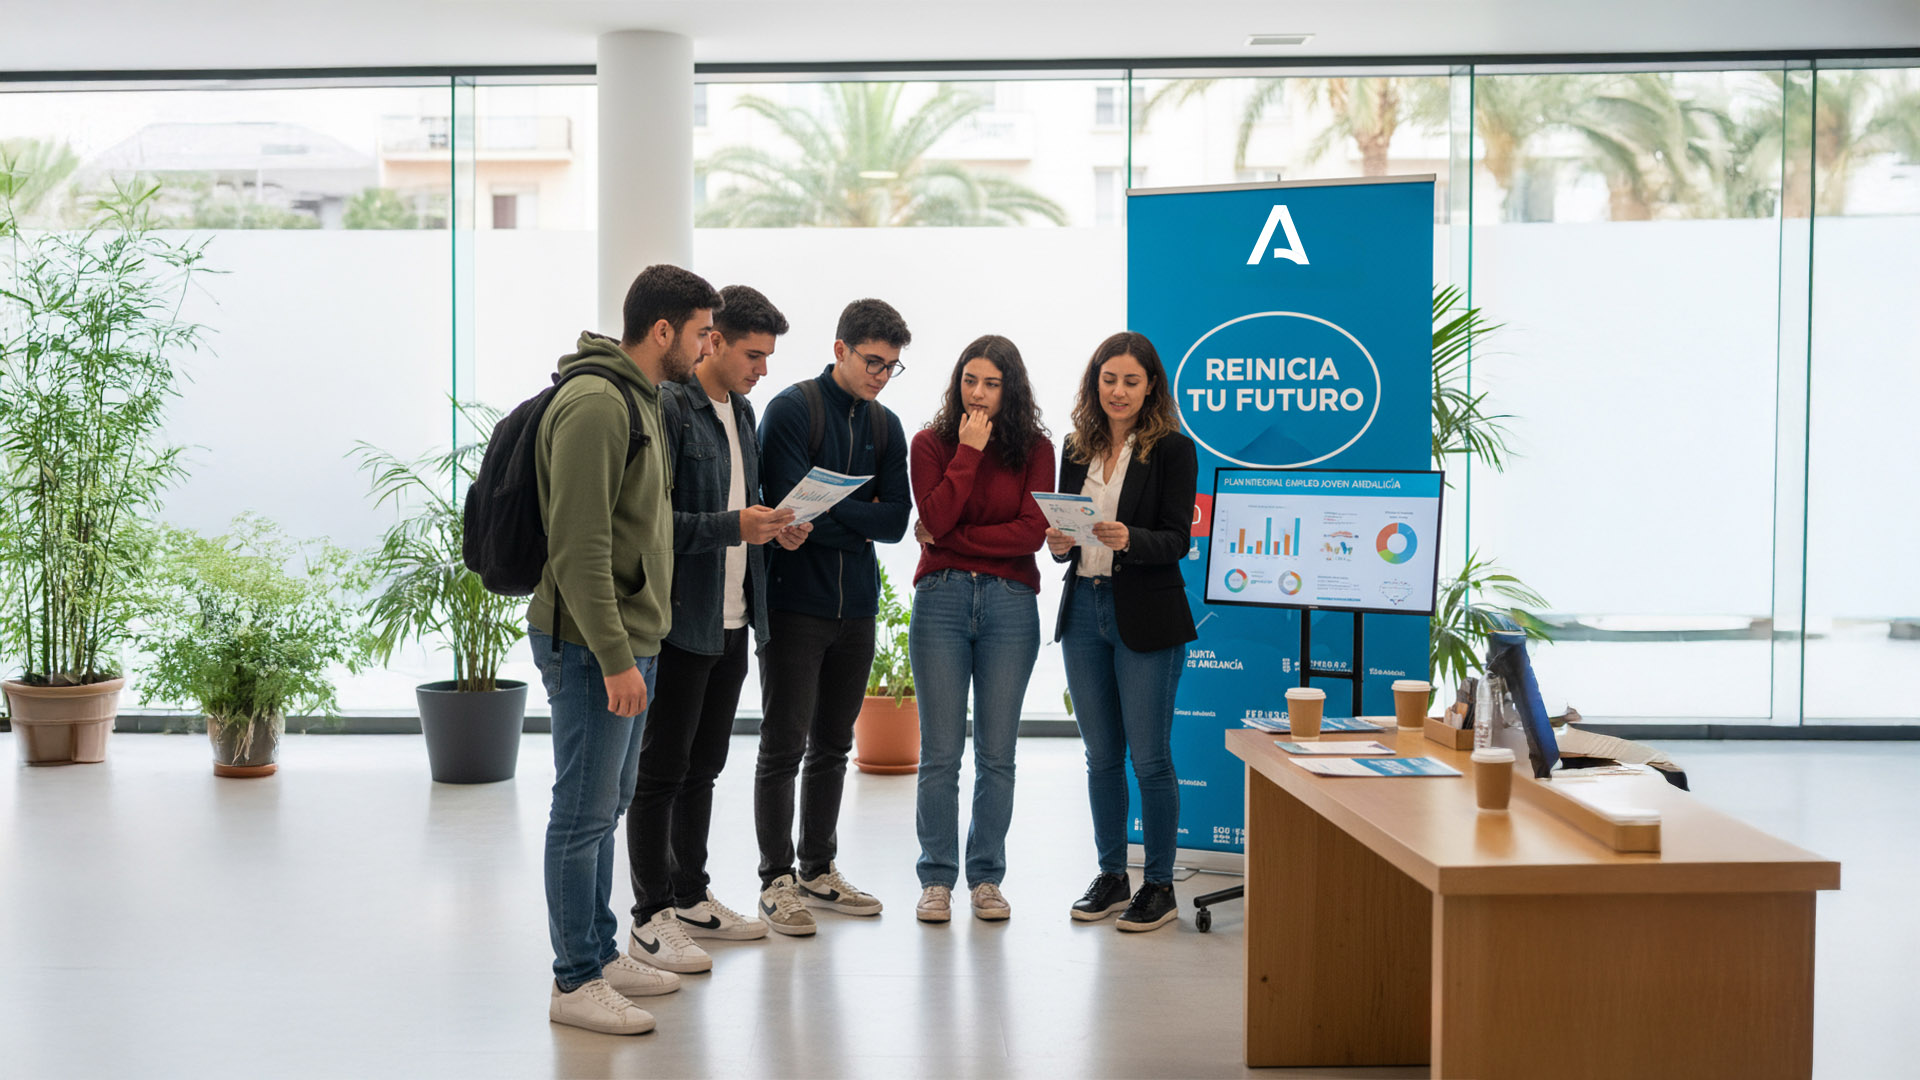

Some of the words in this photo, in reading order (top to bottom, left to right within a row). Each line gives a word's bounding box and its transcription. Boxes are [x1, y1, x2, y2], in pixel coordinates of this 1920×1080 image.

[1206, 358, 1339, 381] REINICIA
[1187, 389, 1226, 411] TU
[1236, 388, 1364, 411] FUTURO
[1321, 479, 1350, 488] JOVEN
